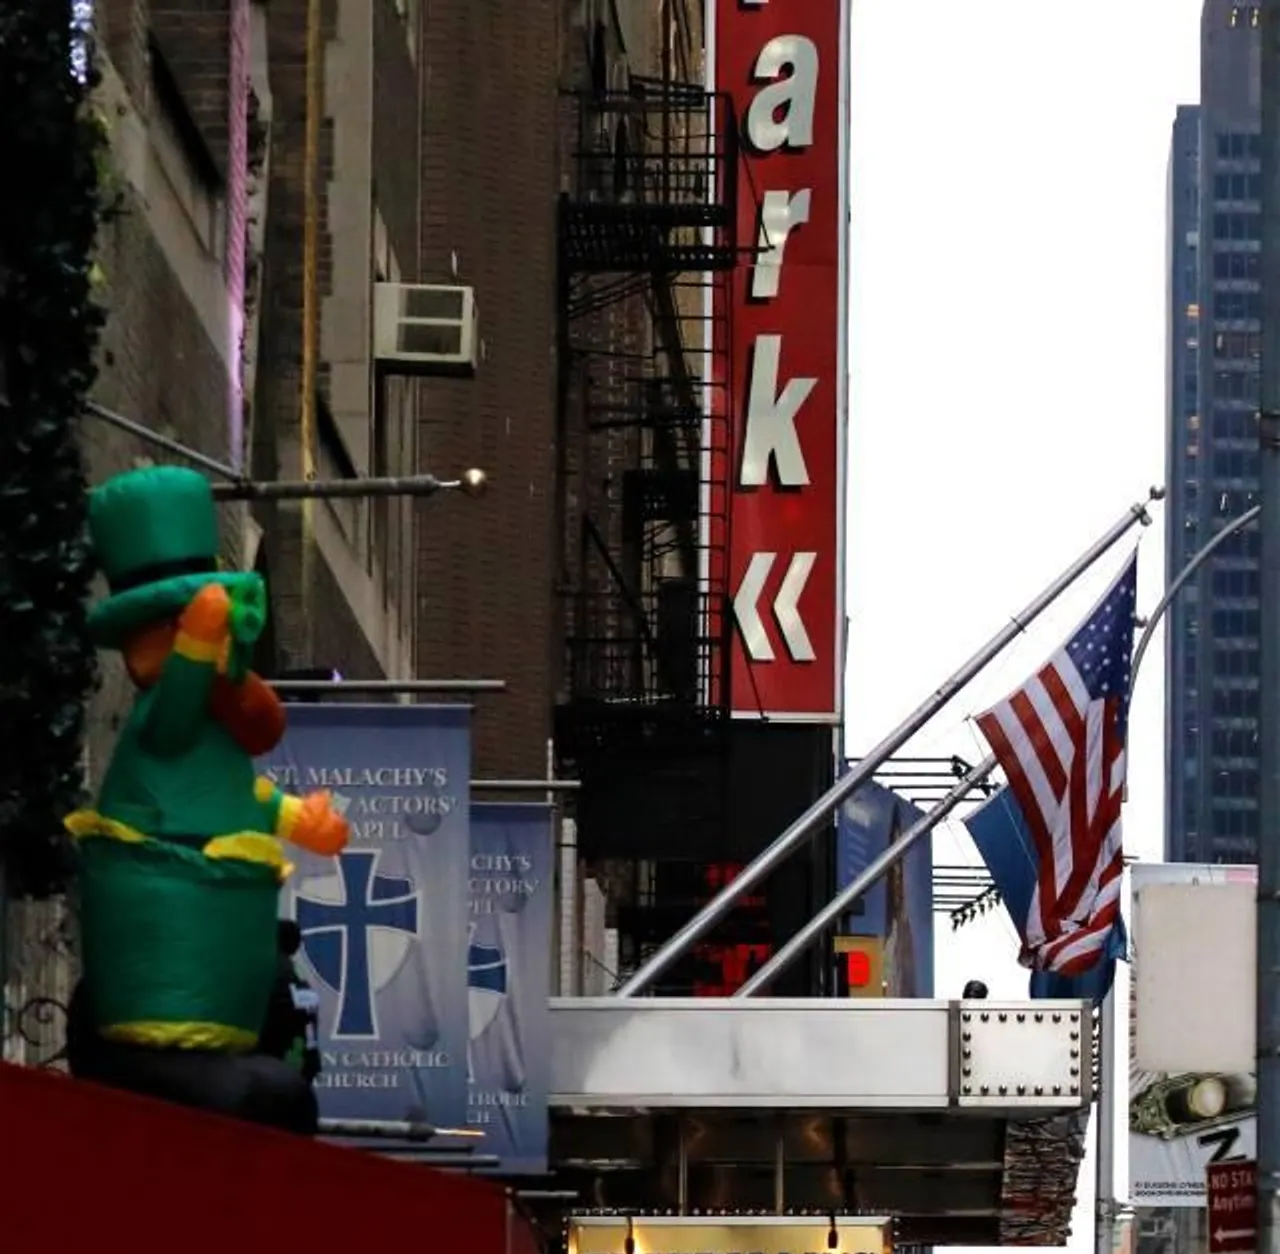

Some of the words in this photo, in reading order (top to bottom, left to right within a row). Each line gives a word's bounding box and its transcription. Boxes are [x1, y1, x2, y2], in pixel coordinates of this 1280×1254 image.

[738, 0, 820, 488] ark
[306, 767, 448, 787] MALACHY'S
[358, 796, 456, 815] ACTORS'
[351, 822, 404, 839] APEL
[341, 1052, 450, 1068] CATHOLIC
